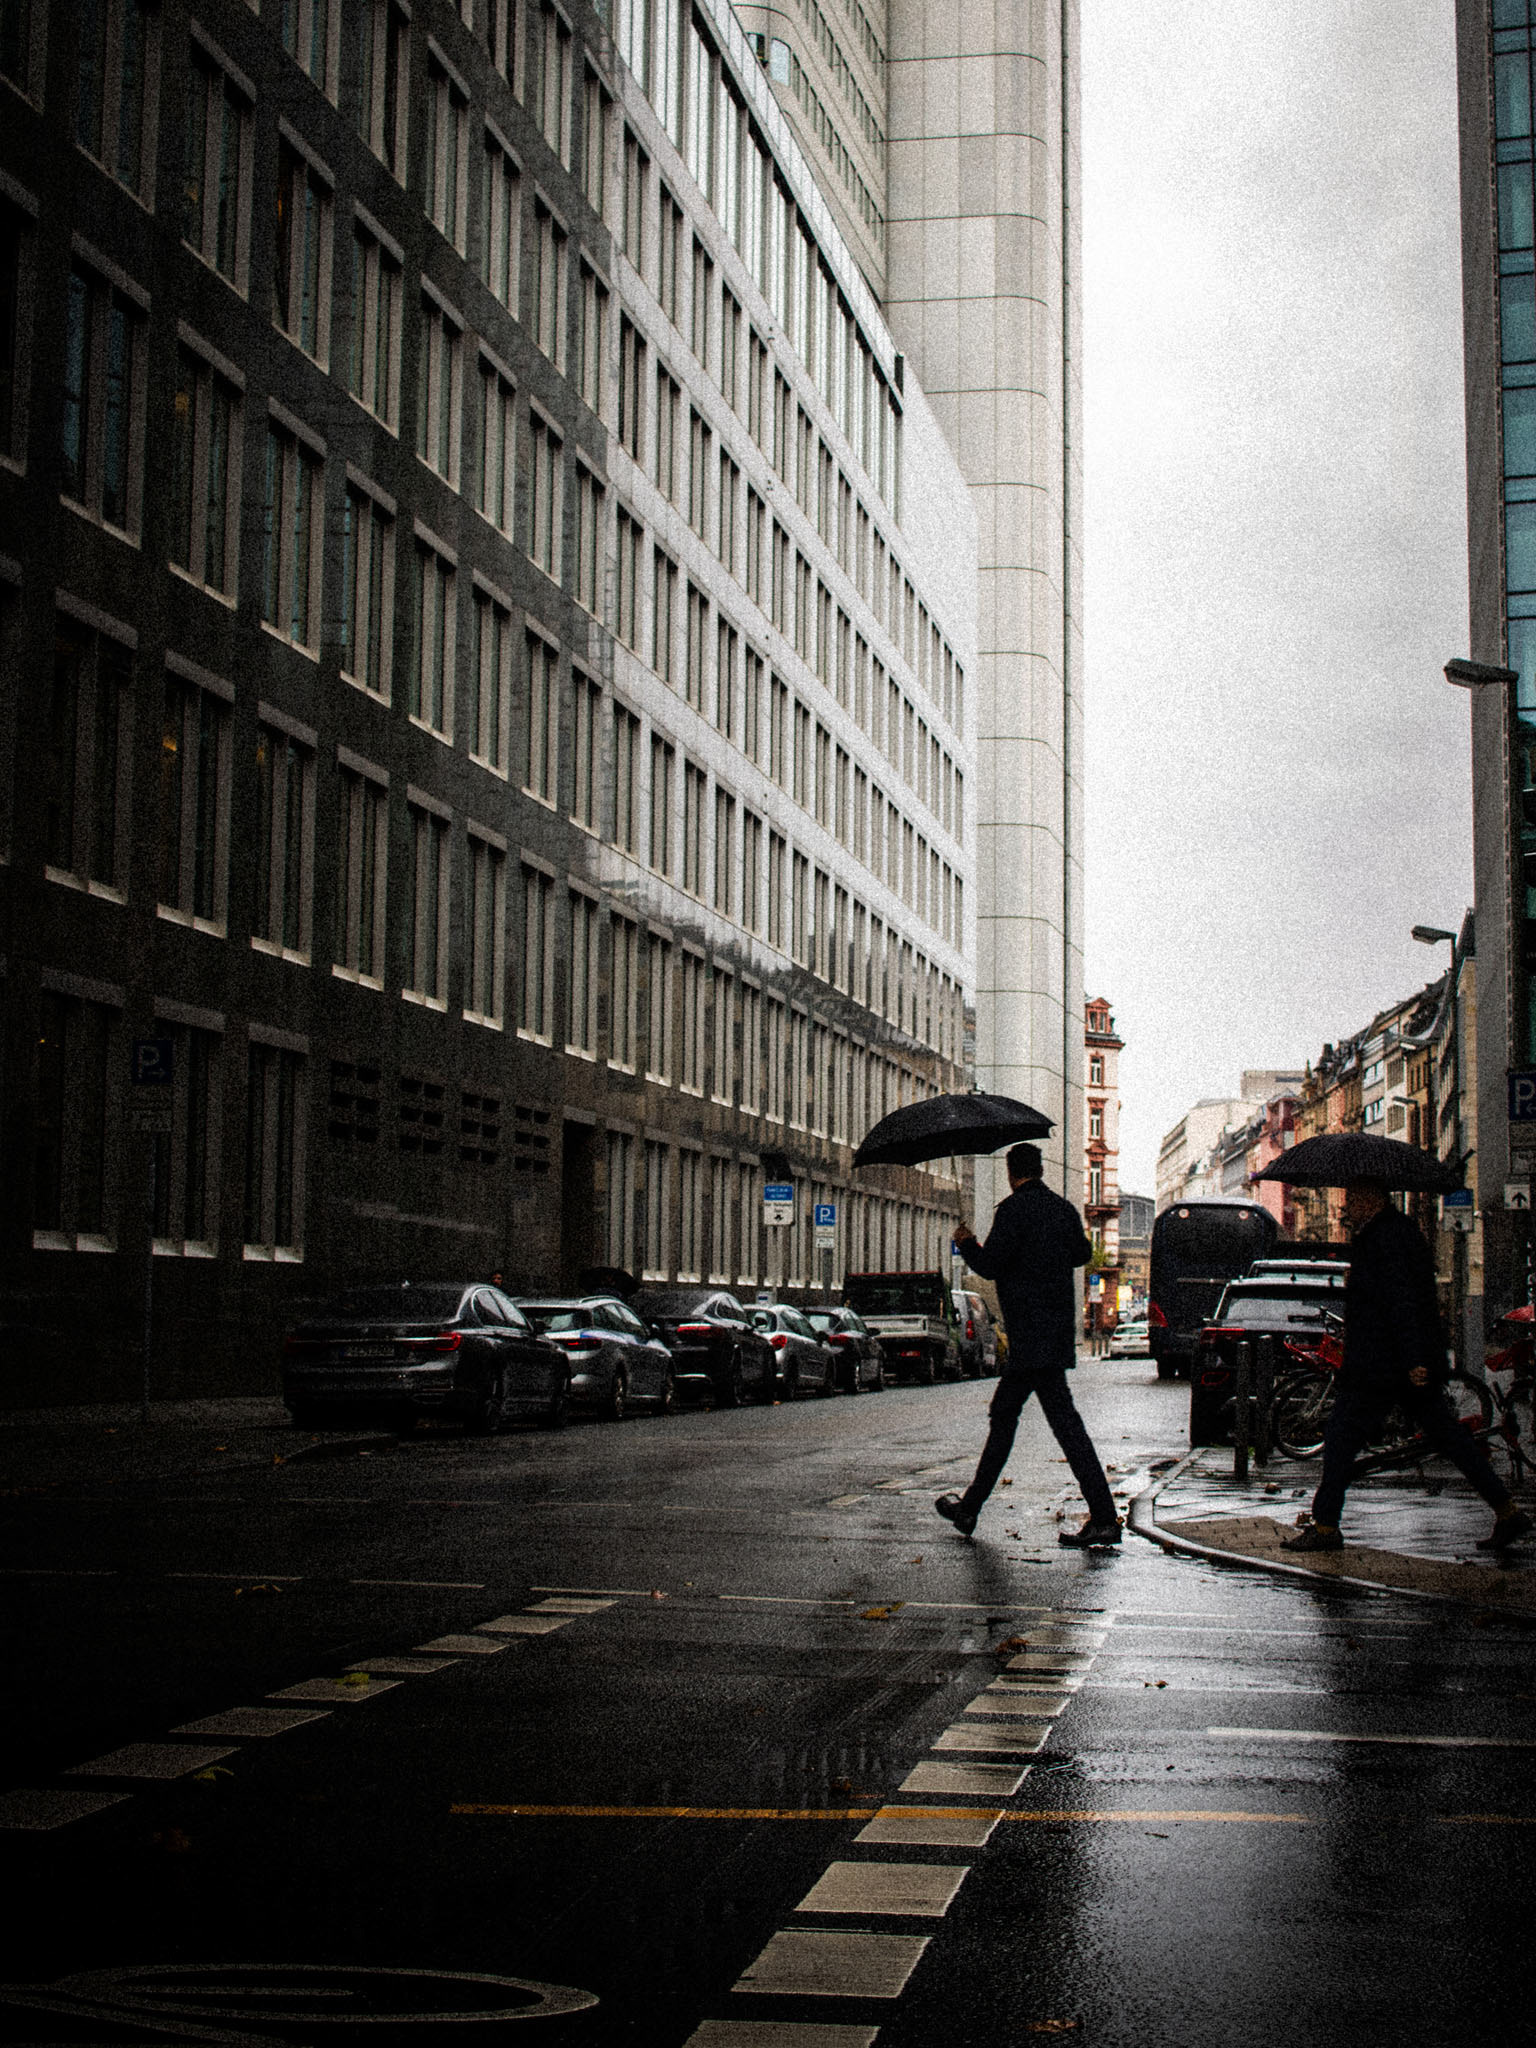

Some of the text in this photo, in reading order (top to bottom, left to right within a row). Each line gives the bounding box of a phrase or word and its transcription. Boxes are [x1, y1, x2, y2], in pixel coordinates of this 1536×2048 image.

[136, 1045, 161, 1079] P
[1515, 1079, 1536, 1115] P
[820, 1207, 831, 1223] P
